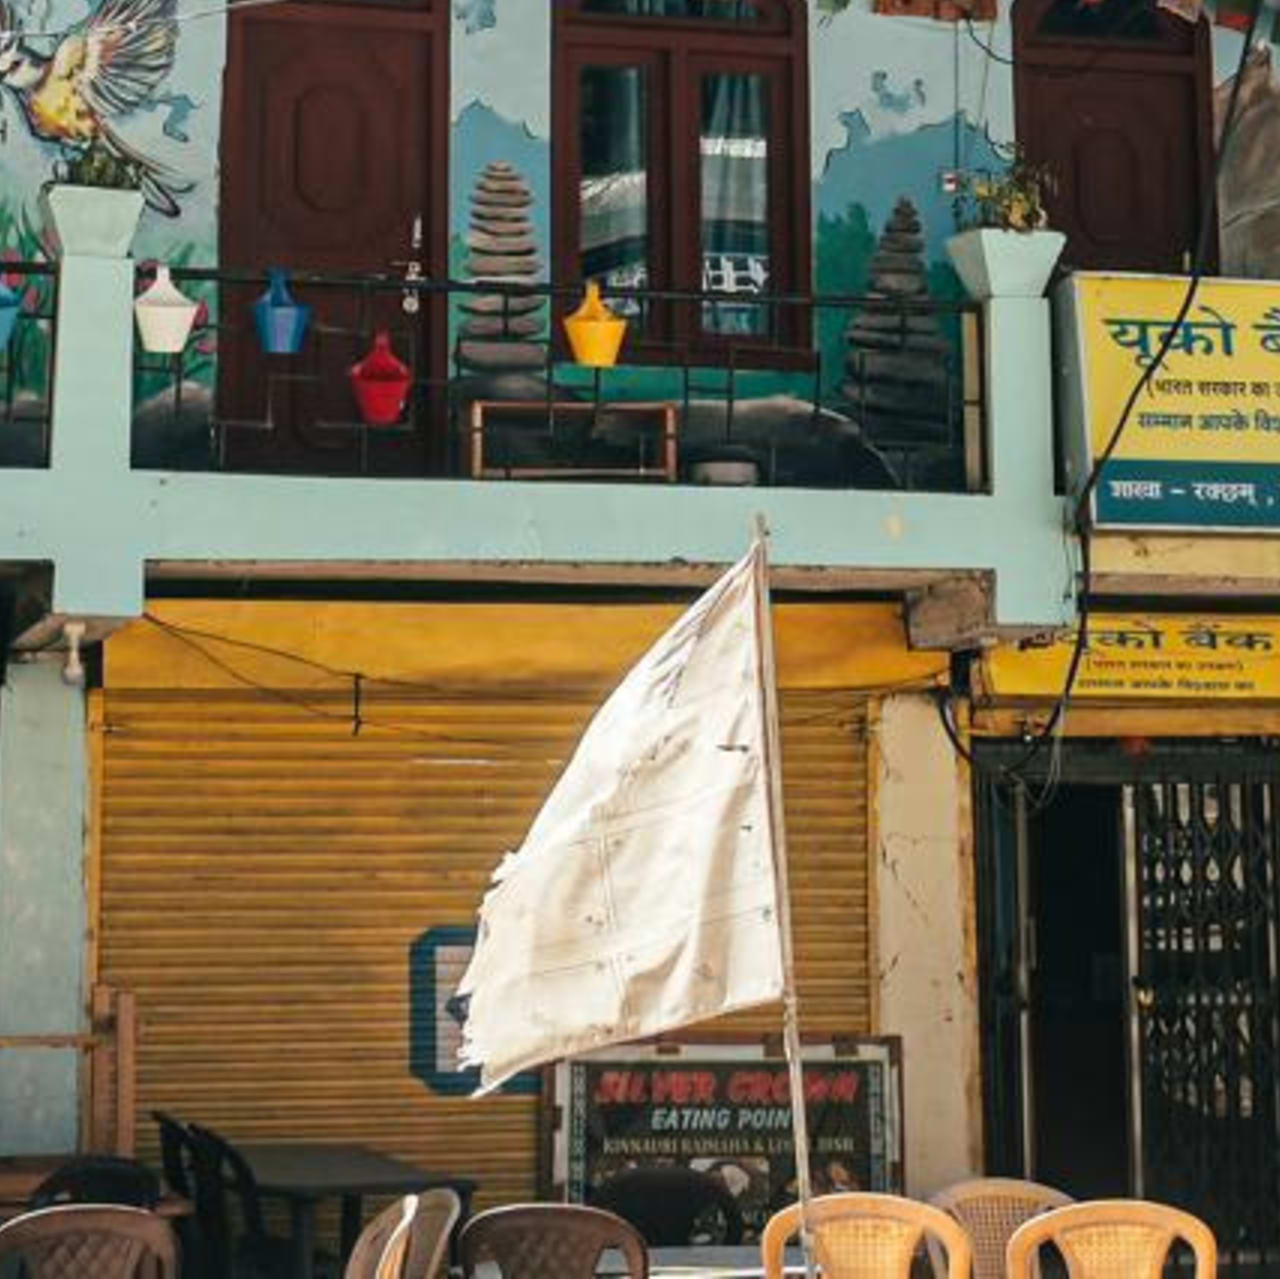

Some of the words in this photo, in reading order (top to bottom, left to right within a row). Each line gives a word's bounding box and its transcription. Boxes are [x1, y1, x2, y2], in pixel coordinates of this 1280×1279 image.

[1102, 304, 1237, 372] यूको
[651, 1107, 732, 1131] EATING
[737, 1108, 793, 1130] POIN
